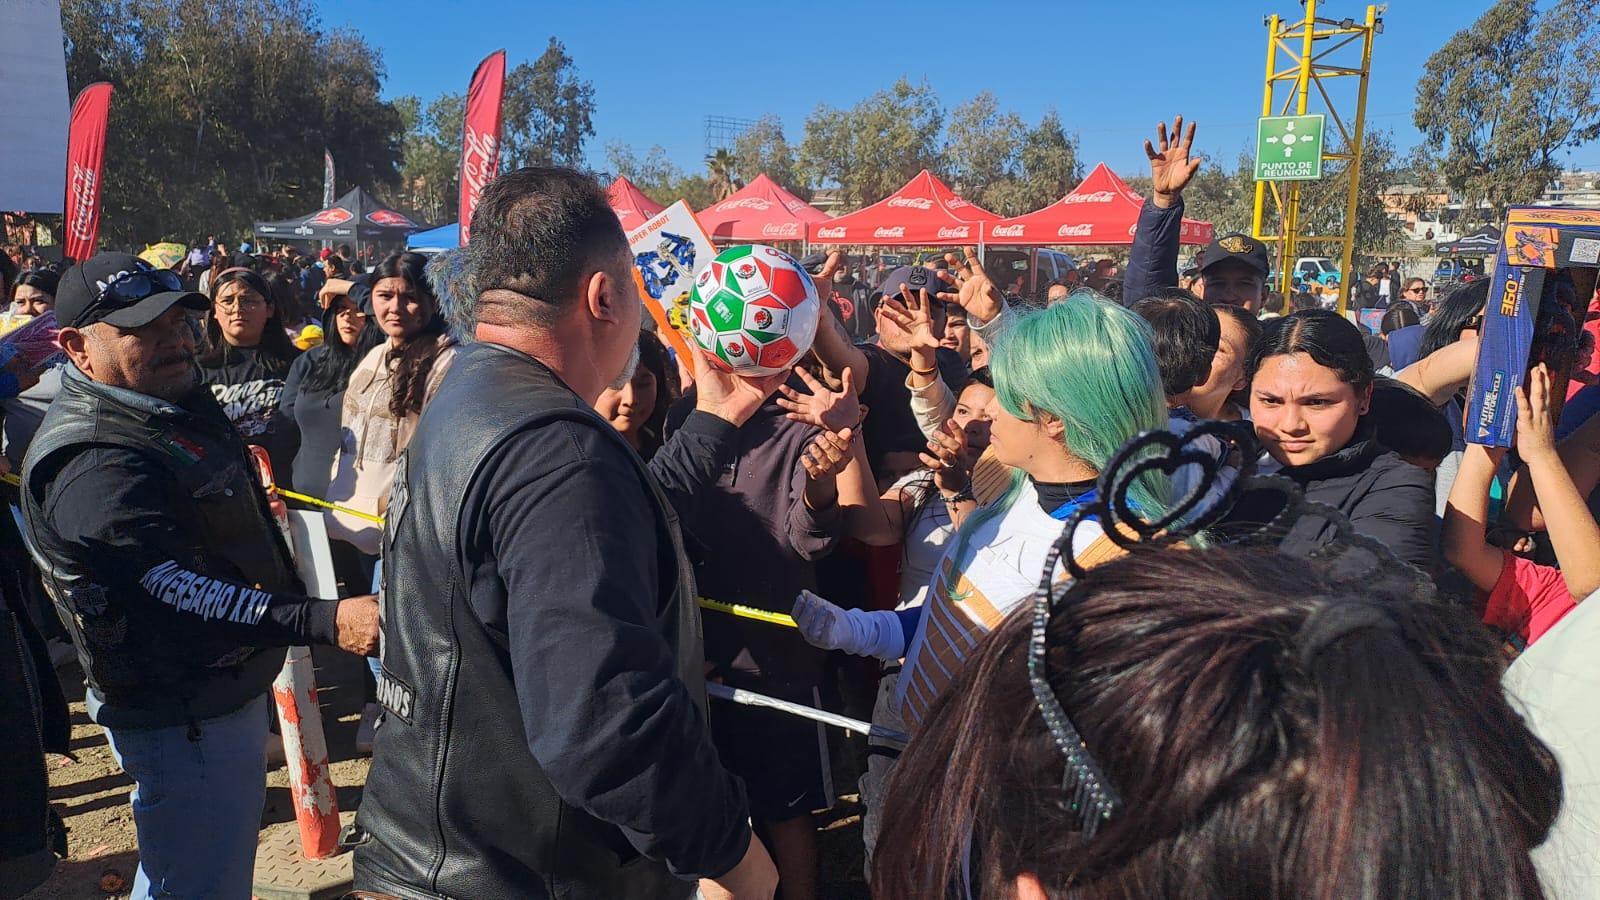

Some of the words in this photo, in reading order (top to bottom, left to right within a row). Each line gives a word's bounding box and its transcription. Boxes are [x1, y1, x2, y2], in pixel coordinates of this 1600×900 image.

[1261, 162, 1296, 170] PUNTO
[1298, 161, 1312, 169] DE
[647, 214, 671, 233] ROBOT
[1480, 391, 1492, 427] FUTURE
[1487, 372, 1502, 424] MOTORCYCLE
